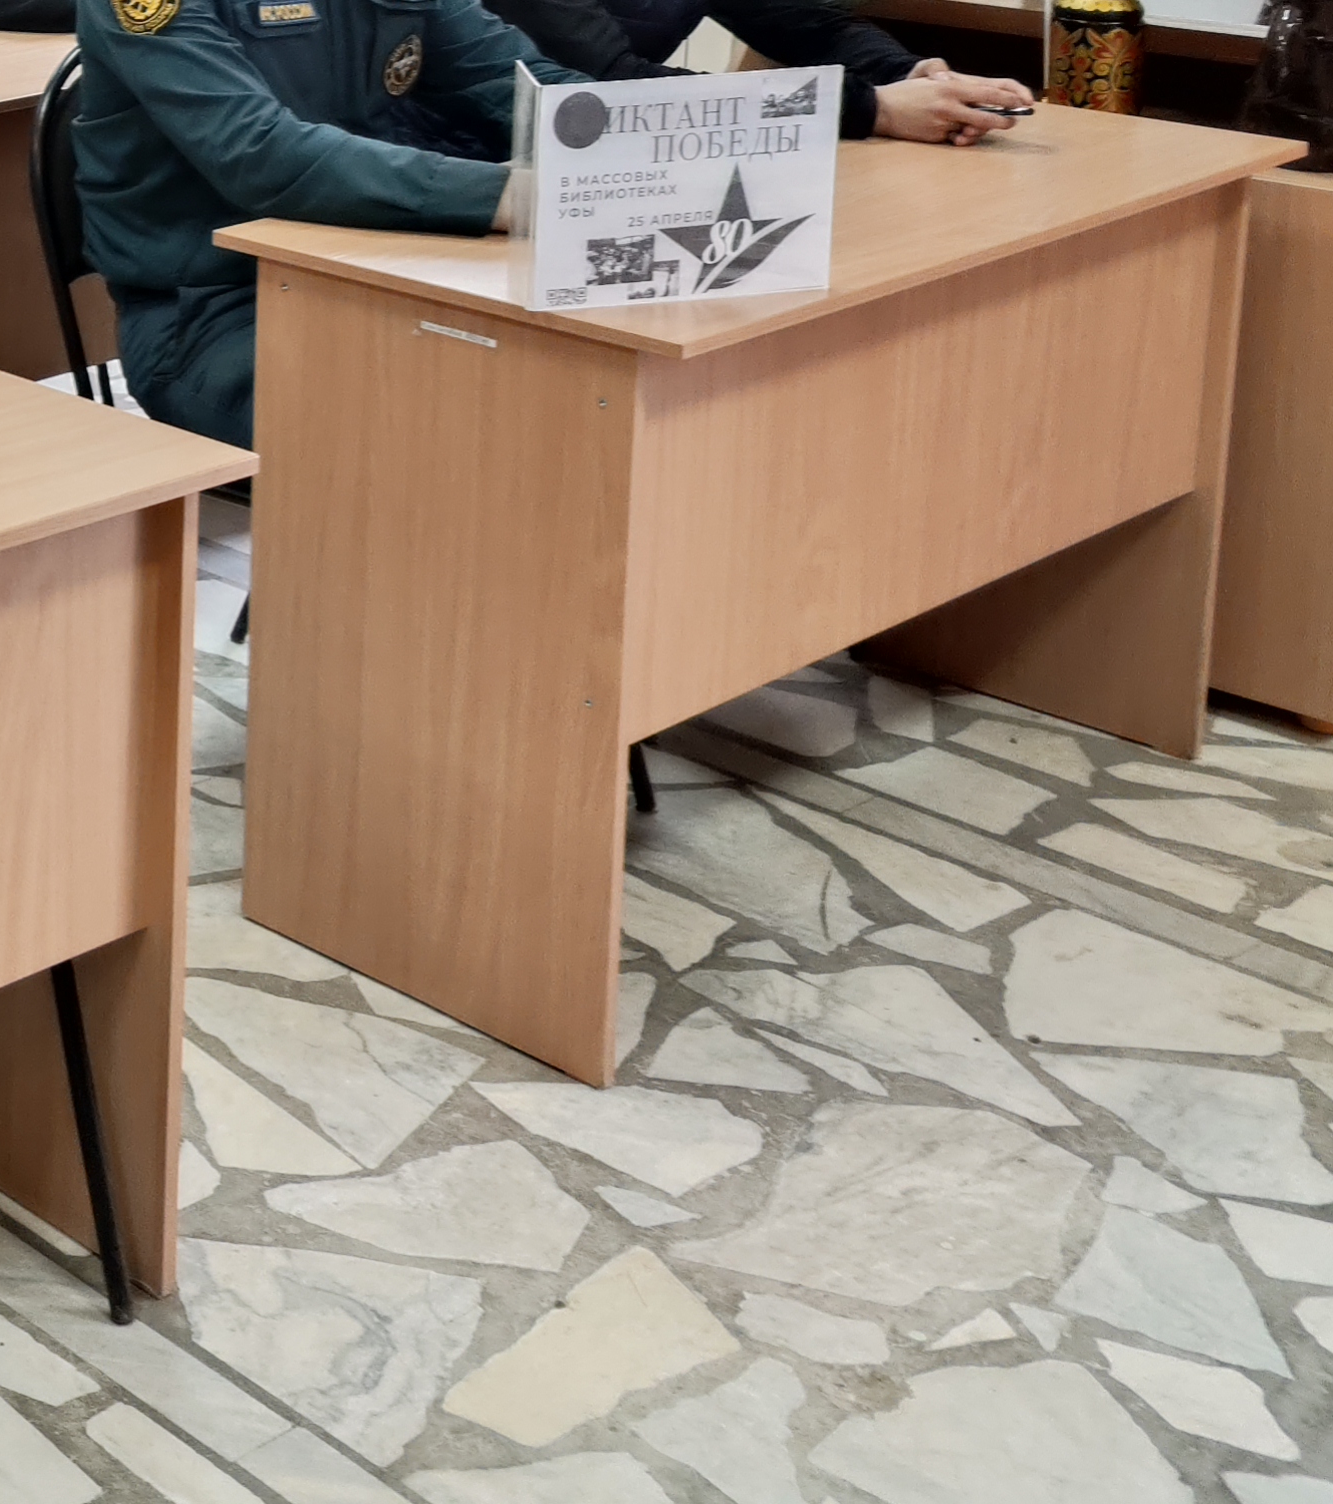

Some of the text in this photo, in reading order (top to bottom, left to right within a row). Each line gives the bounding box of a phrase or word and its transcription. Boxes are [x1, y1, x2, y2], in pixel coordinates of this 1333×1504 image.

[600, 96, 746, 135] ИКТАНТ
[652, 123, 803, 164] ПОБЕДЫ
[561, 170, 669, 188] В МАССОВЫХ
[559, 184, 678, 204] БИБЛИОТЕКАХ
[557, 206, 596, 220] УФЫ
[627, 210, 714, 228] 25 АПРЕЛЯ
[701, 218, 755, 265] 80
